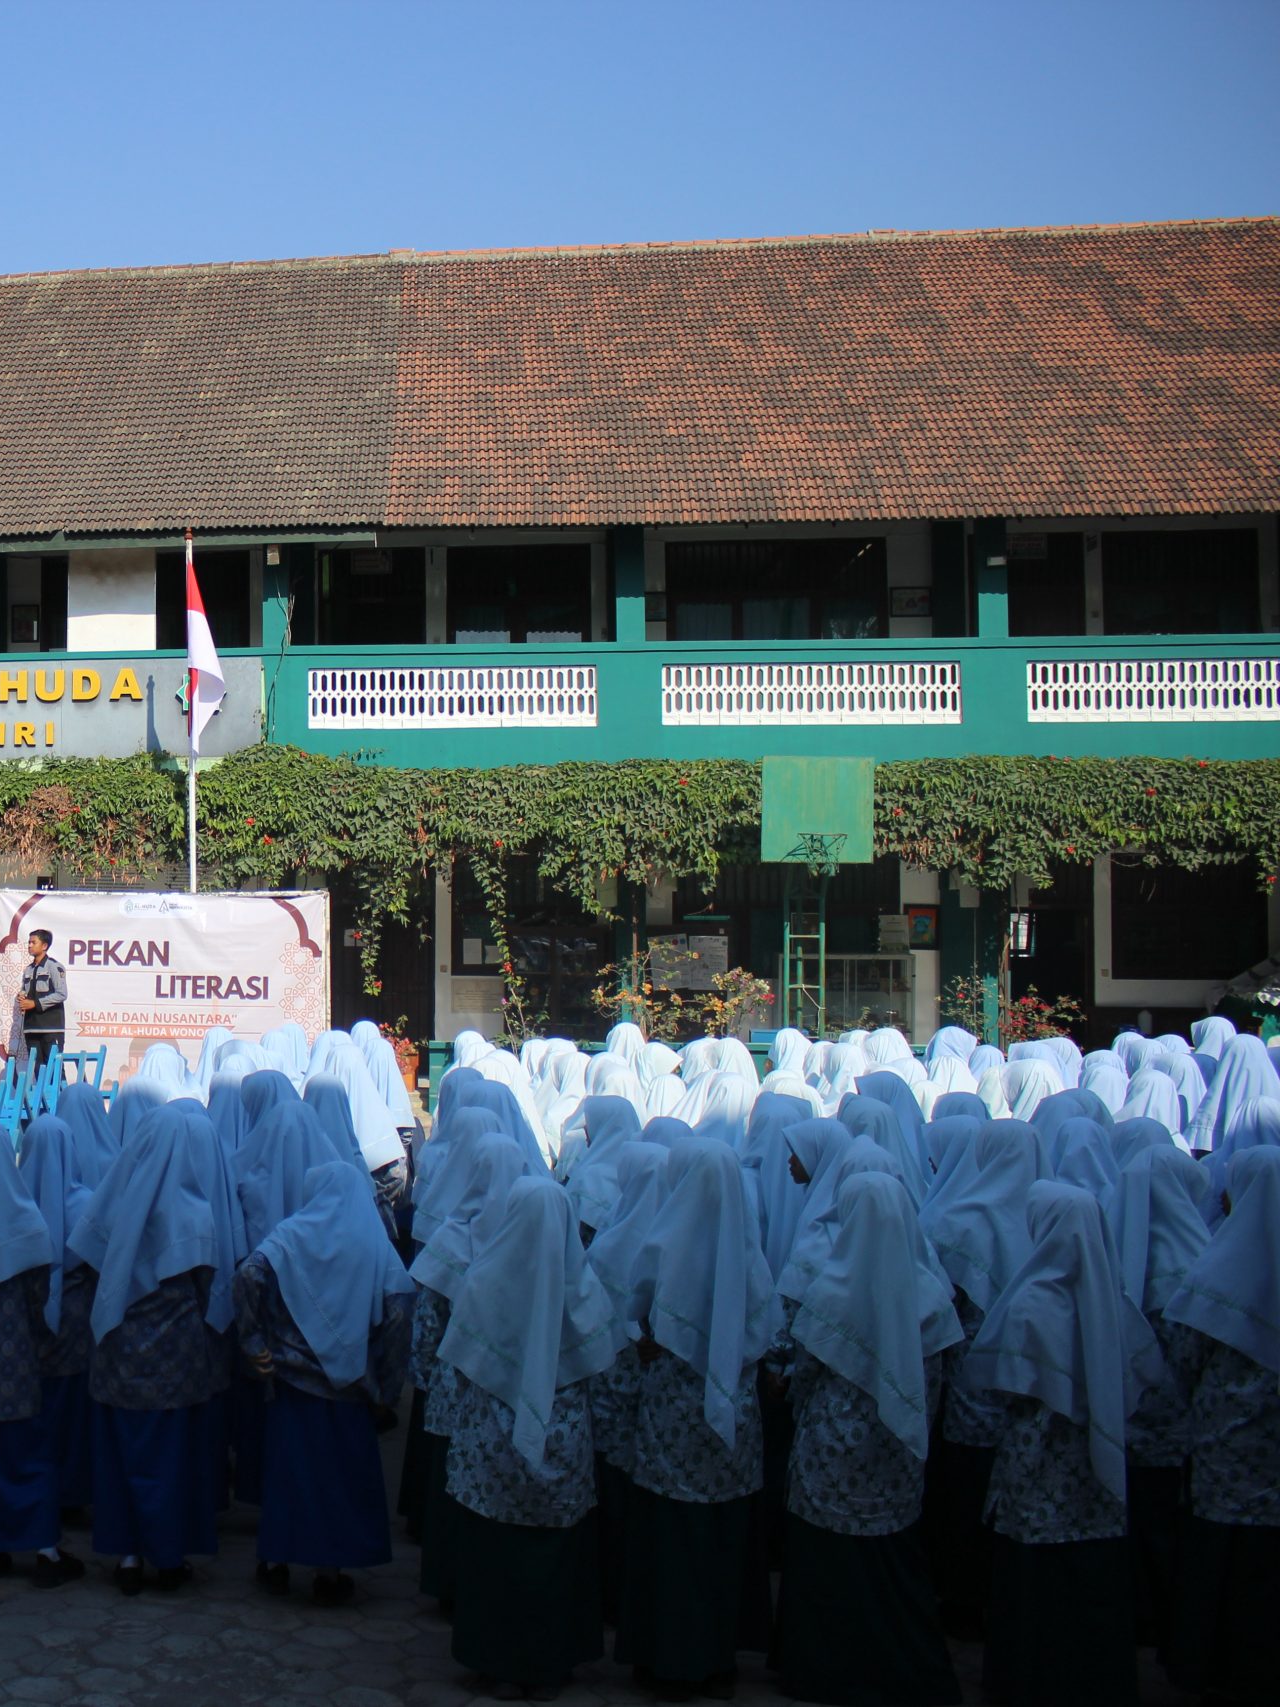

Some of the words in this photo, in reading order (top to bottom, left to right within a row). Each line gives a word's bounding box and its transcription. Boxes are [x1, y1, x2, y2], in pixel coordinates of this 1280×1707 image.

[68, 939, 170, 967] PEKAN
[155, 975, 269, 1000] LITERASI
[122, 1012, 149, 1023] DAN
[84, 1025, 106, 1034] SMP
[109, 1027, 118, 1035] IT
[121, 1027, 167, 1037] AL-HUDA
[170, 1027, 208, 1038] WONO
